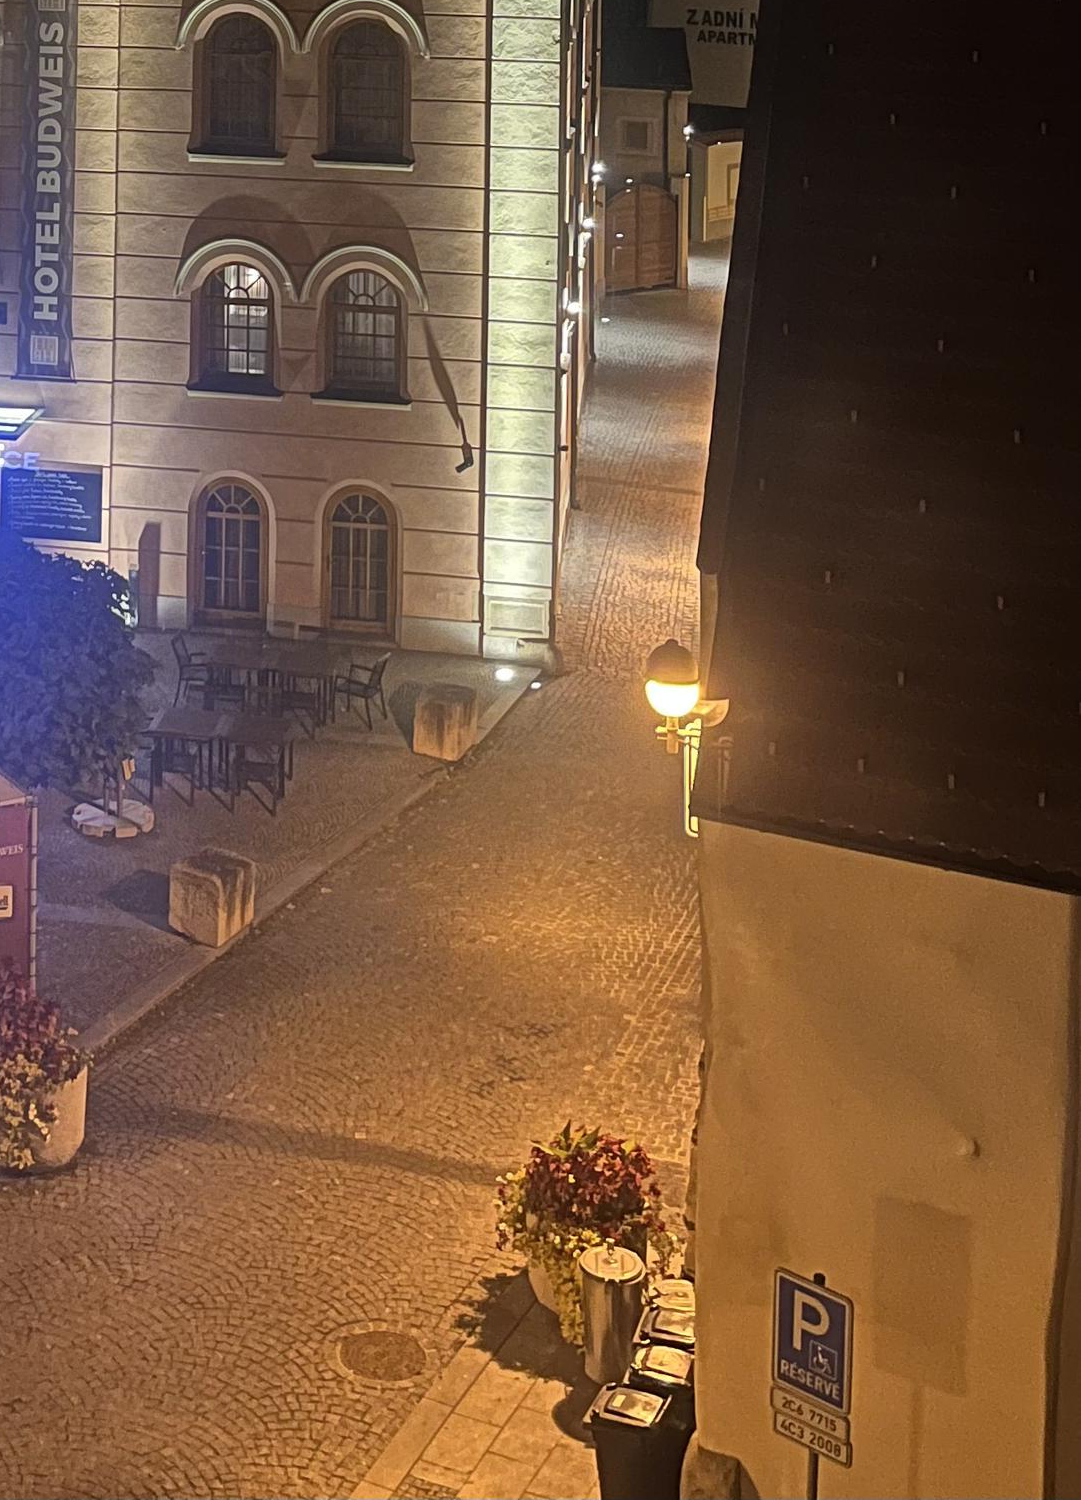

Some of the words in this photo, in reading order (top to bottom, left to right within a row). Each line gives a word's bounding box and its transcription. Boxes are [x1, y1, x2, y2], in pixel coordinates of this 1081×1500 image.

[686, 7, 743, 29] ZADNÍ
[36, 21, 65, 193] BUDWEIS
[33, 202, 61, 321] HOTEL
[792, 1288, 830, 1352] P
[780, 1359, 840, 1400] RÉSERVÉ
[781, 1395, 805, 1417] 2C6
[809, 1408, 837, 1433] 7715
[780, 1418, 805, 1441] 4C3
[809, 1431, 842, 1458] 2008
